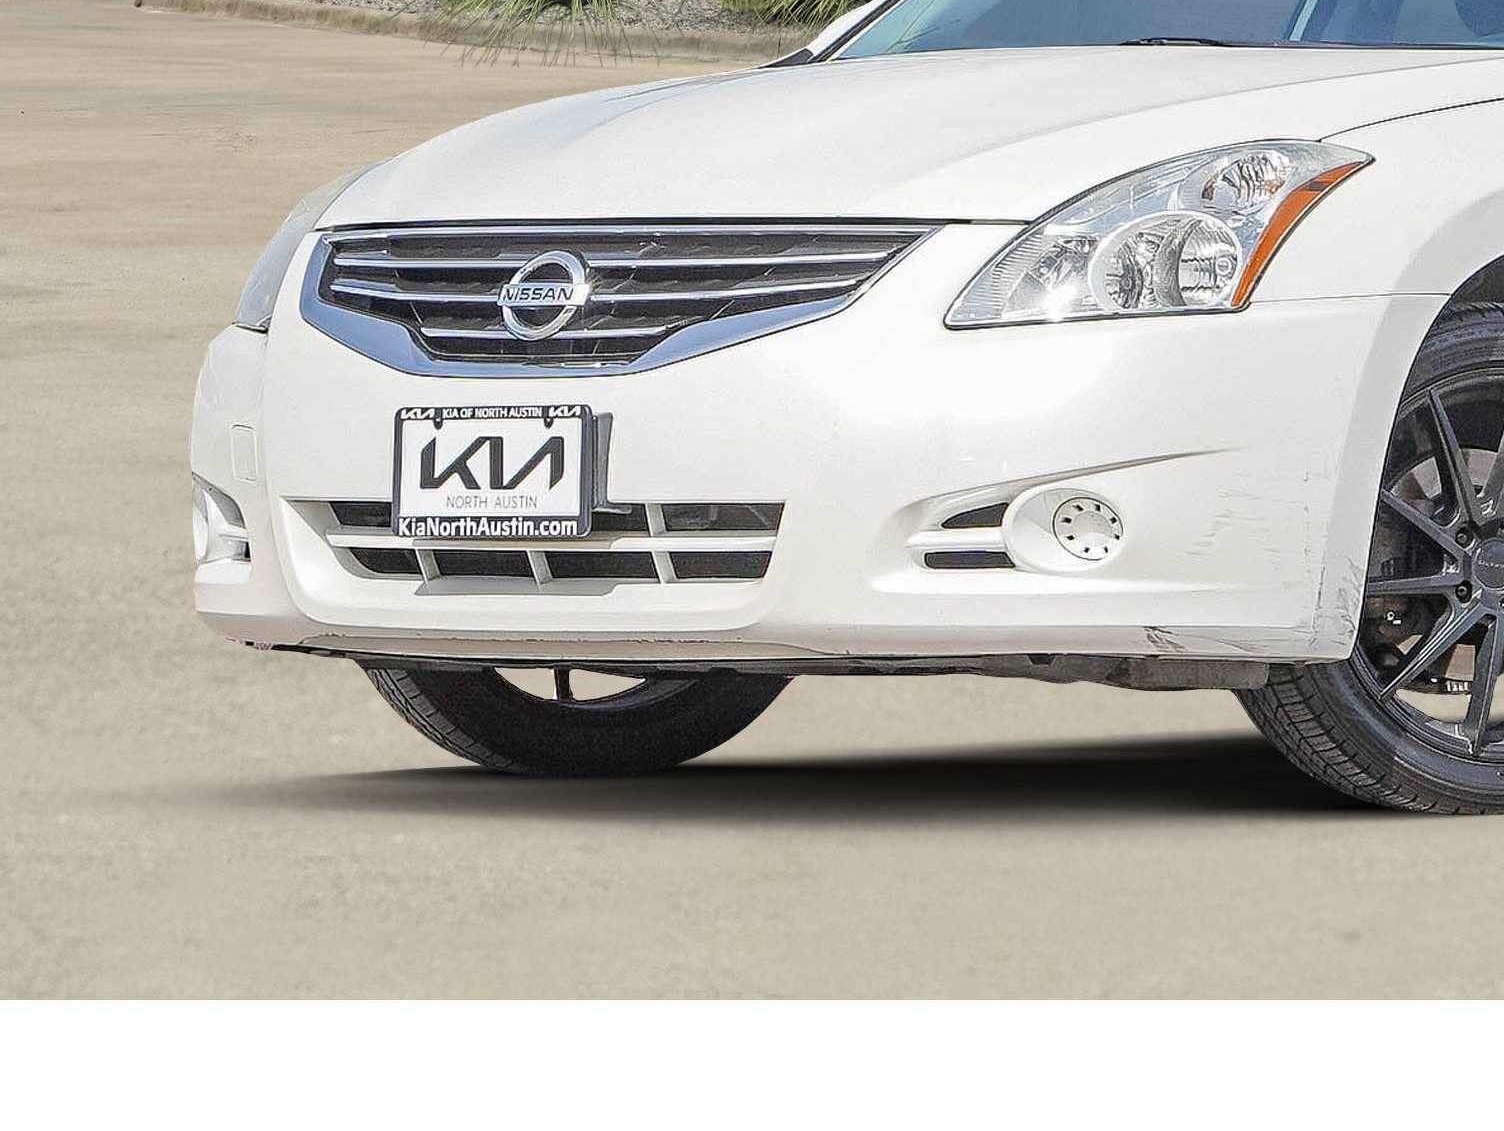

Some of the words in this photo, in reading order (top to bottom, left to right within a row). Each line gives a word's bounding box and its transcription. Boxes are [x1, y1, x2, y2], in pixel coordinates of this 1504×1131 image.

[503, 287, 574, 301] NISSAN
[401, 407, 435, 420] KIA
[442, 408, 459, 419] KIA
[460, 408, 473, 418] OF
[474, 407, 508, 419] NORTH
[509, 406, 543, 418] AUSTIN
[549, 405, 582, 417] KIA
[420, 436, 565, 490] KIA
[446, 495, 488, 510] NORTH
[494, 495, 538, 509] AUSTIN
[399, 516, 578, 537] KiaNorthAustin.com
